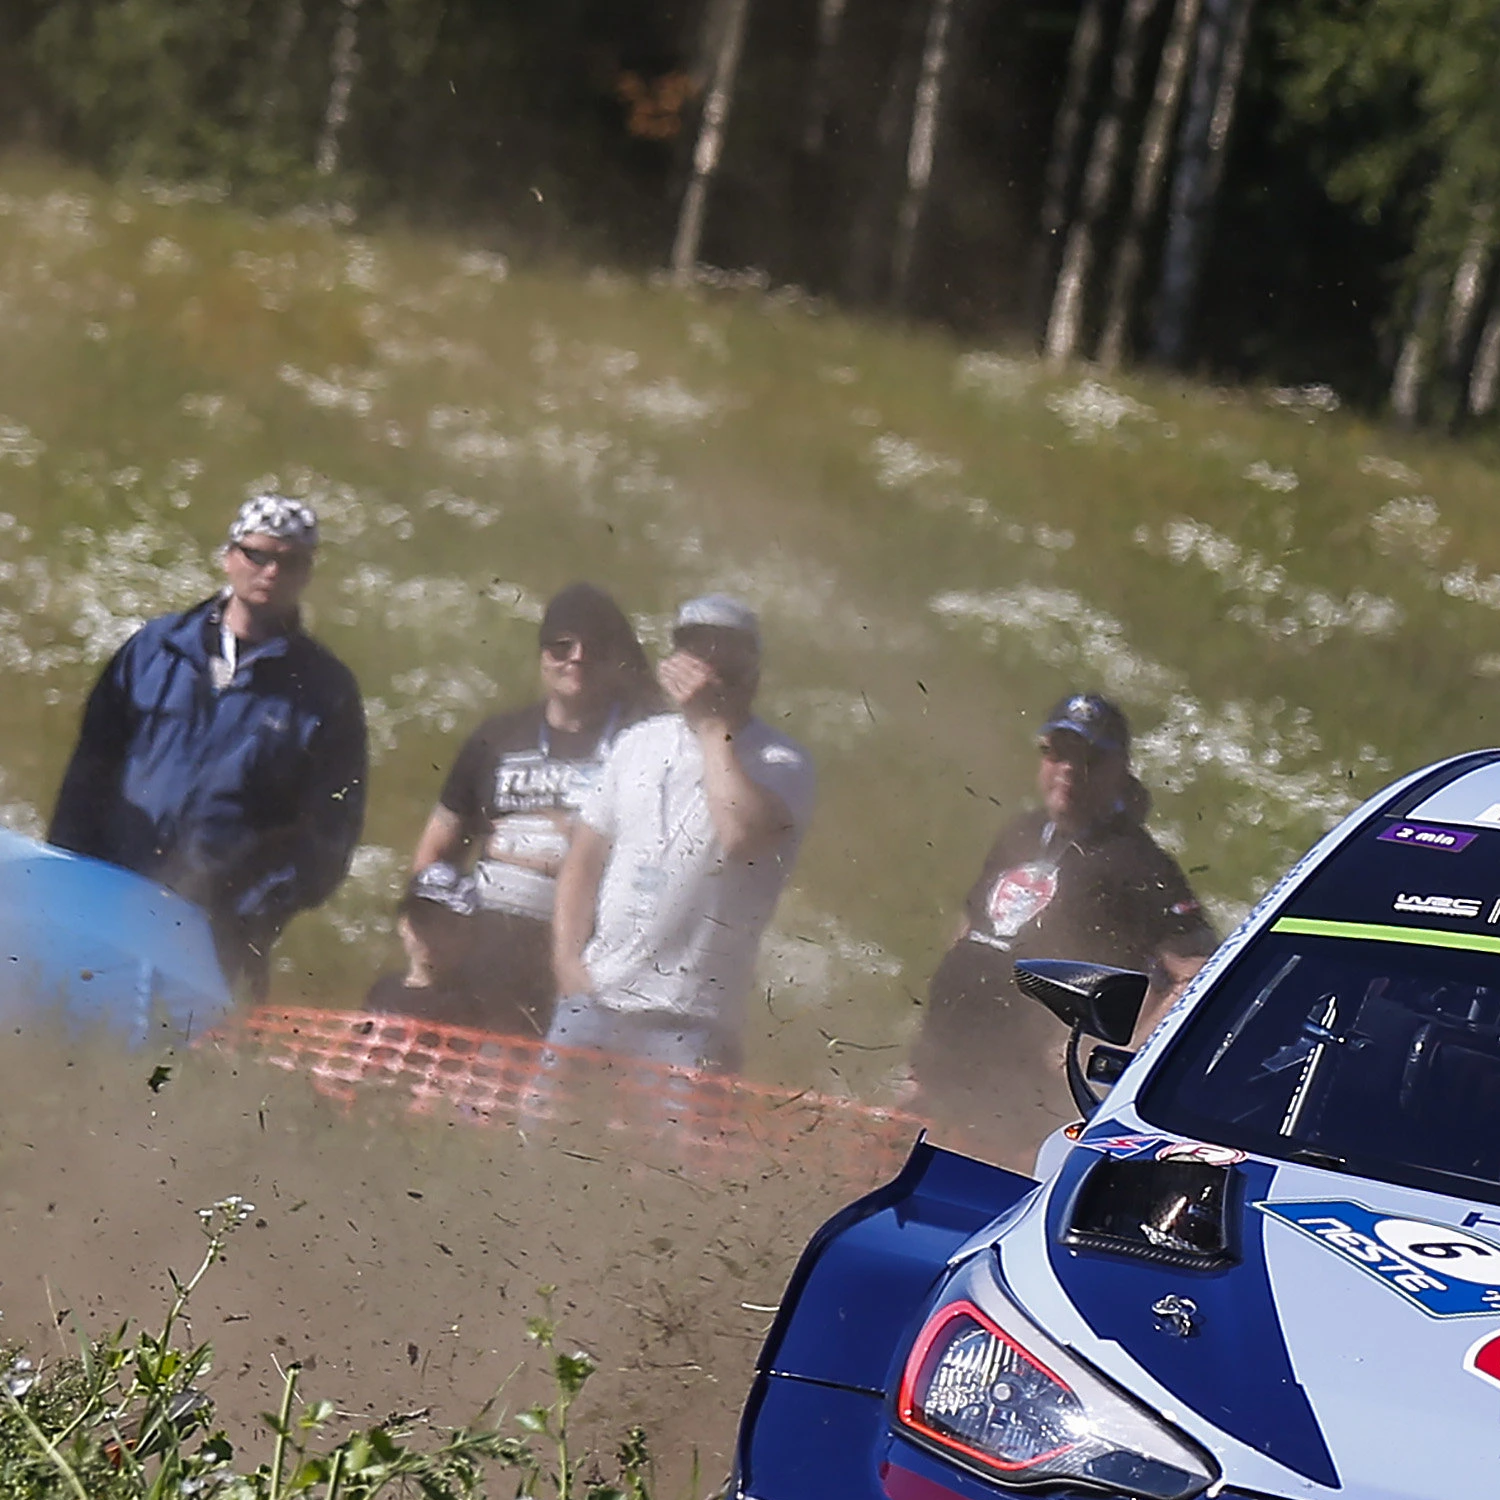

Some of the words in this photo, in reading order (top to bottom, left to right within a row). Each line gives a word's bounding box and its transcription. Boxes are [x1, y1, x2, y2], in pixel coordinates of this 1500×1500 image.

[1396, 827, 1413, 838] 2
[1415, 832, 1455, 845] min
[1408, 1241, 1483, 1269] 6
